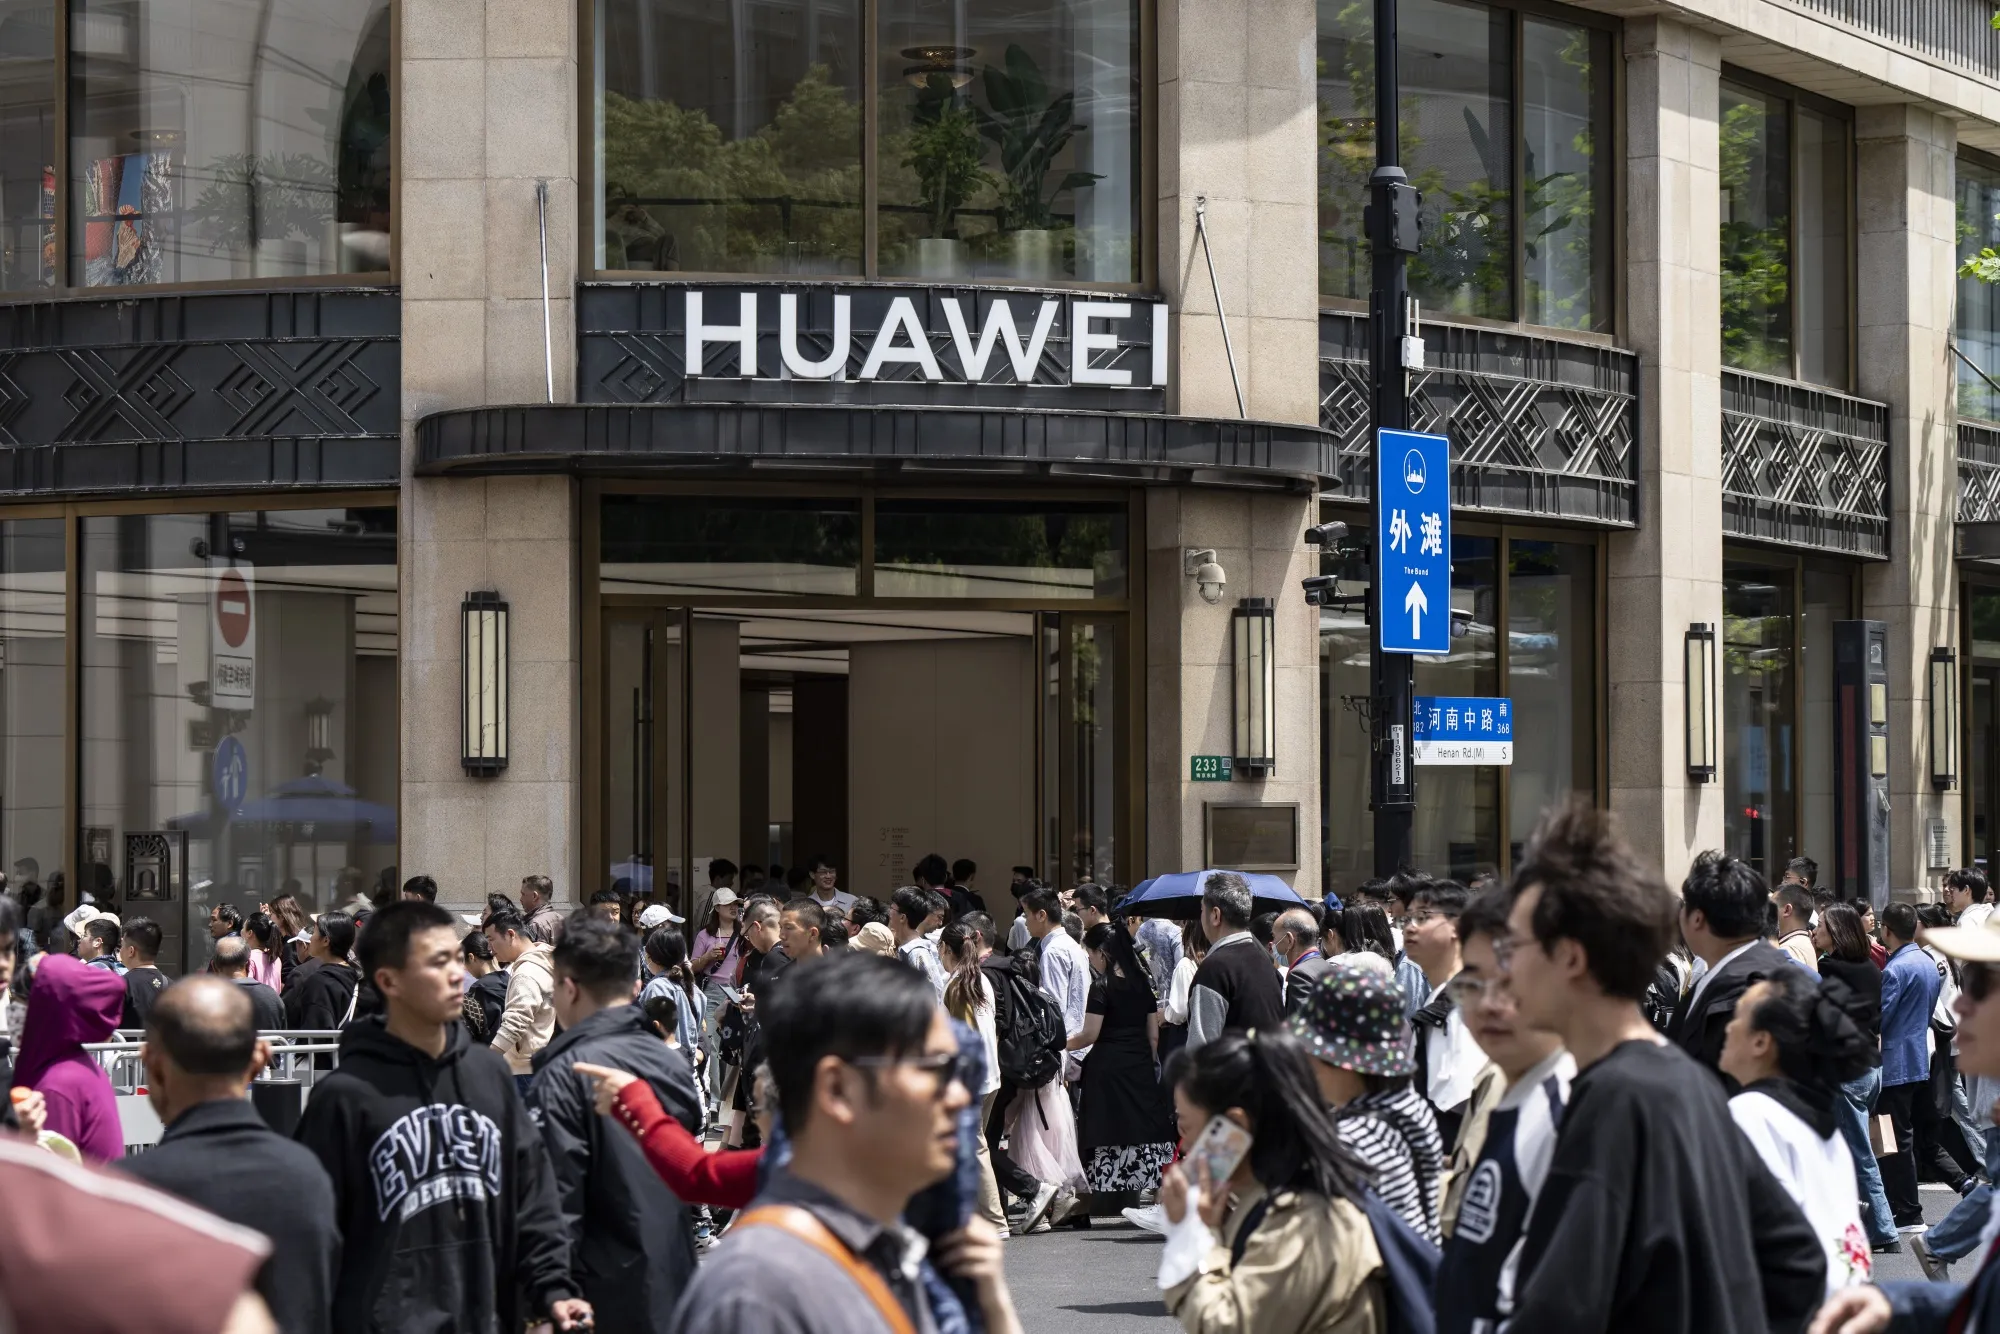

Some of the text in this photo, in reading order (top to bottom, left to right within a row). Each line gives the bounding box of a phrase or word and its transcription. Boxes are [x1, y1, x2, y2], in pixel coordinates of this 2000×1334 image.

[685, 291, 1168, 386] HUAWEI
[1389, 508, 1443, 557] 外滩
[1404, 566, 1414, 575] The
[1413, 701, 1422, 715] 北
[1499, 702, 1508, 717] 南
[1428, 706, 1493, 732] 河南中路
[1497, 723, 1510, 734] 368
[1414, 746, 1507, 760] N Henan Rd.(M) S
[1195, 758, 1217, 772] 233
